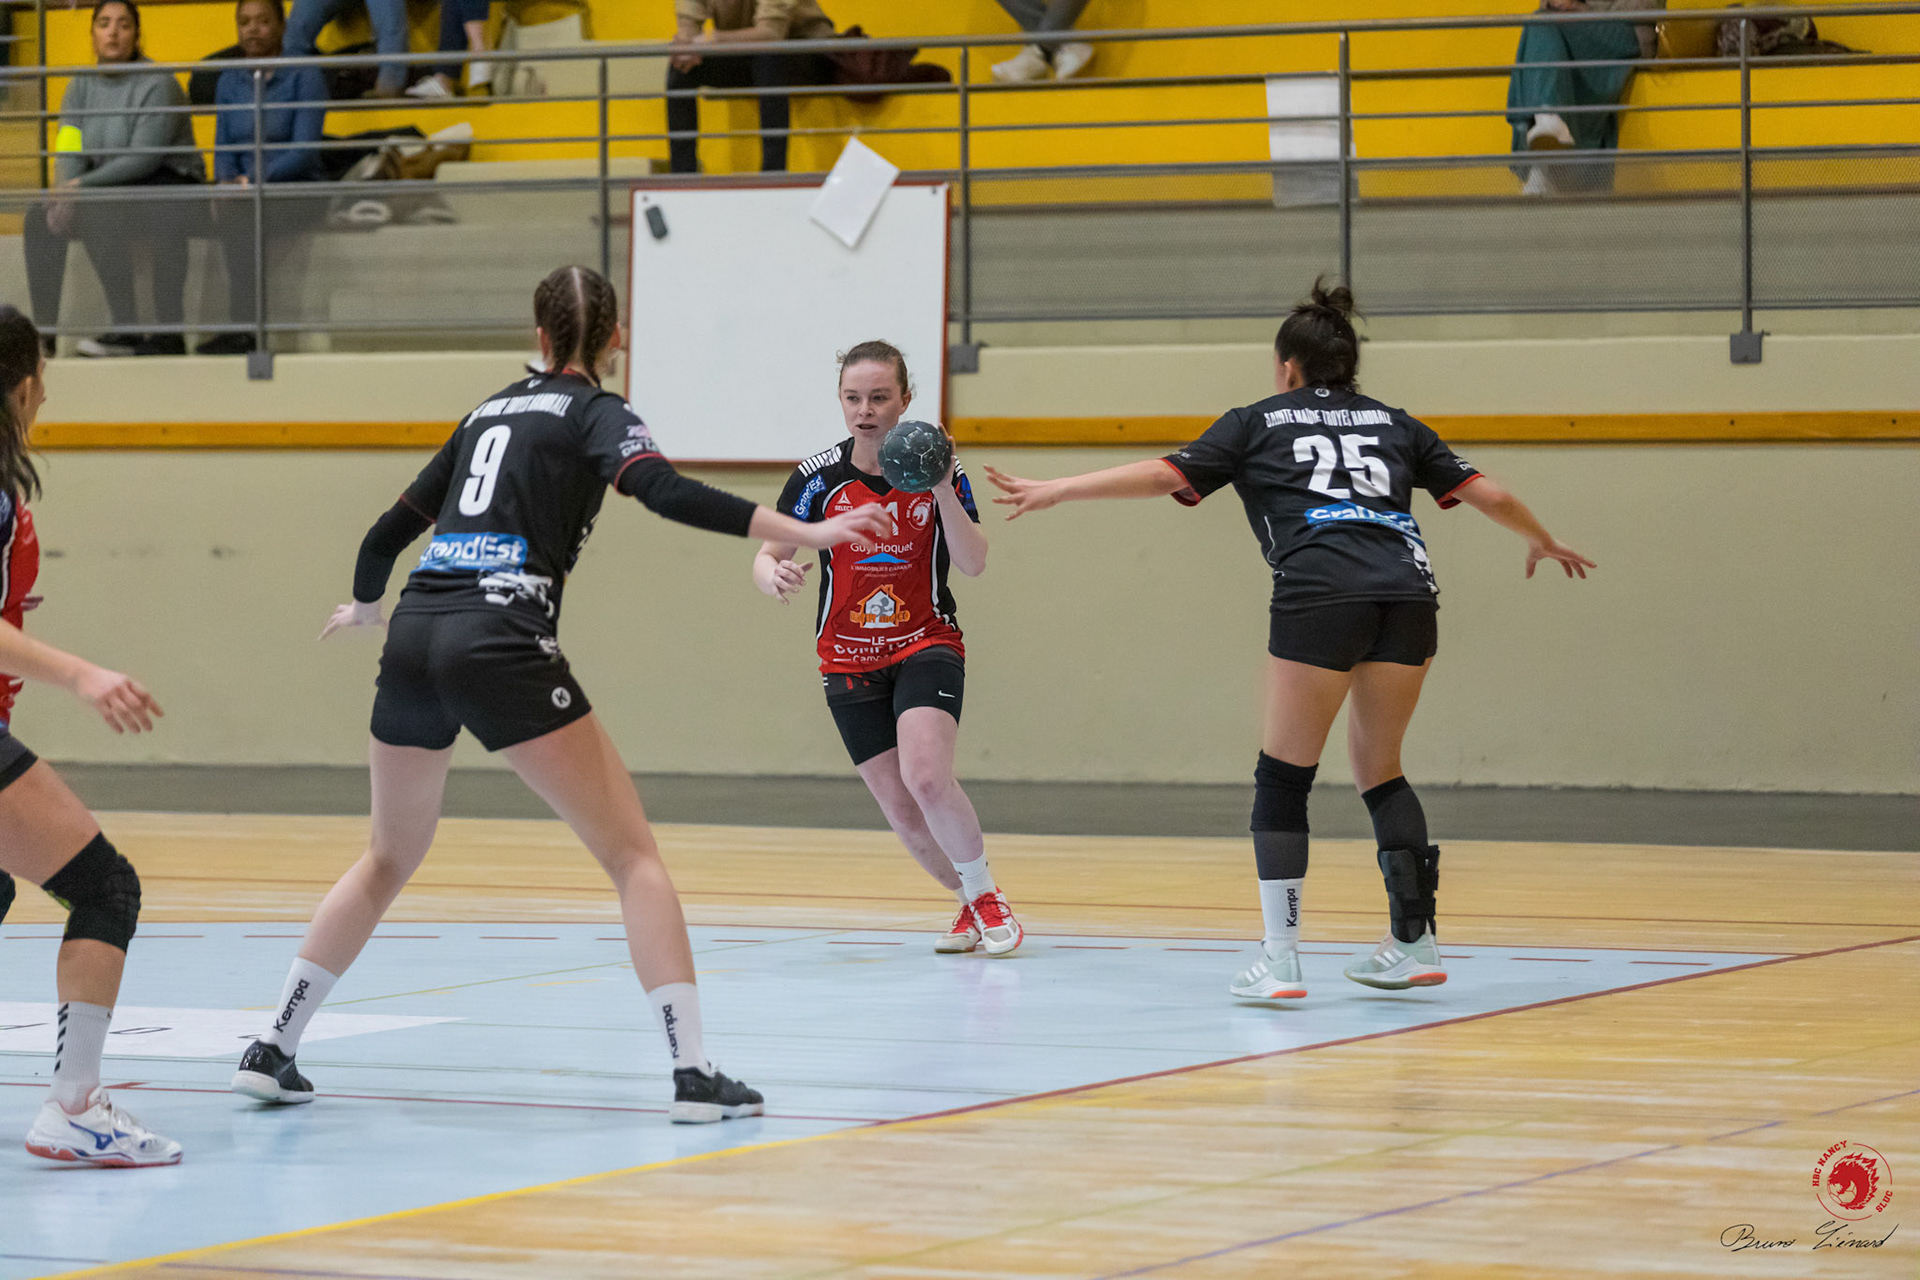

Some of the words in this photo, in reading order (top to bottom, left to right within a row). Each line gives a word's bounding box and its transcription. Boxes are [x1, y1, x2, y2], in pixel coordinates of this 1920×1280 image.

[458, 424, 512, 517] 9
[1292, 433, 1391, 500] 25
[850, 543, 871, 554] Guy
[874, 541, 914, 555] Hoquet
[871, 636, 886, 646] LE
[1286, 888, 1299, 928] Kempa
[272, 979, 311, 1034] Kempa
[662, 1003, 680, 1059] Kempa
